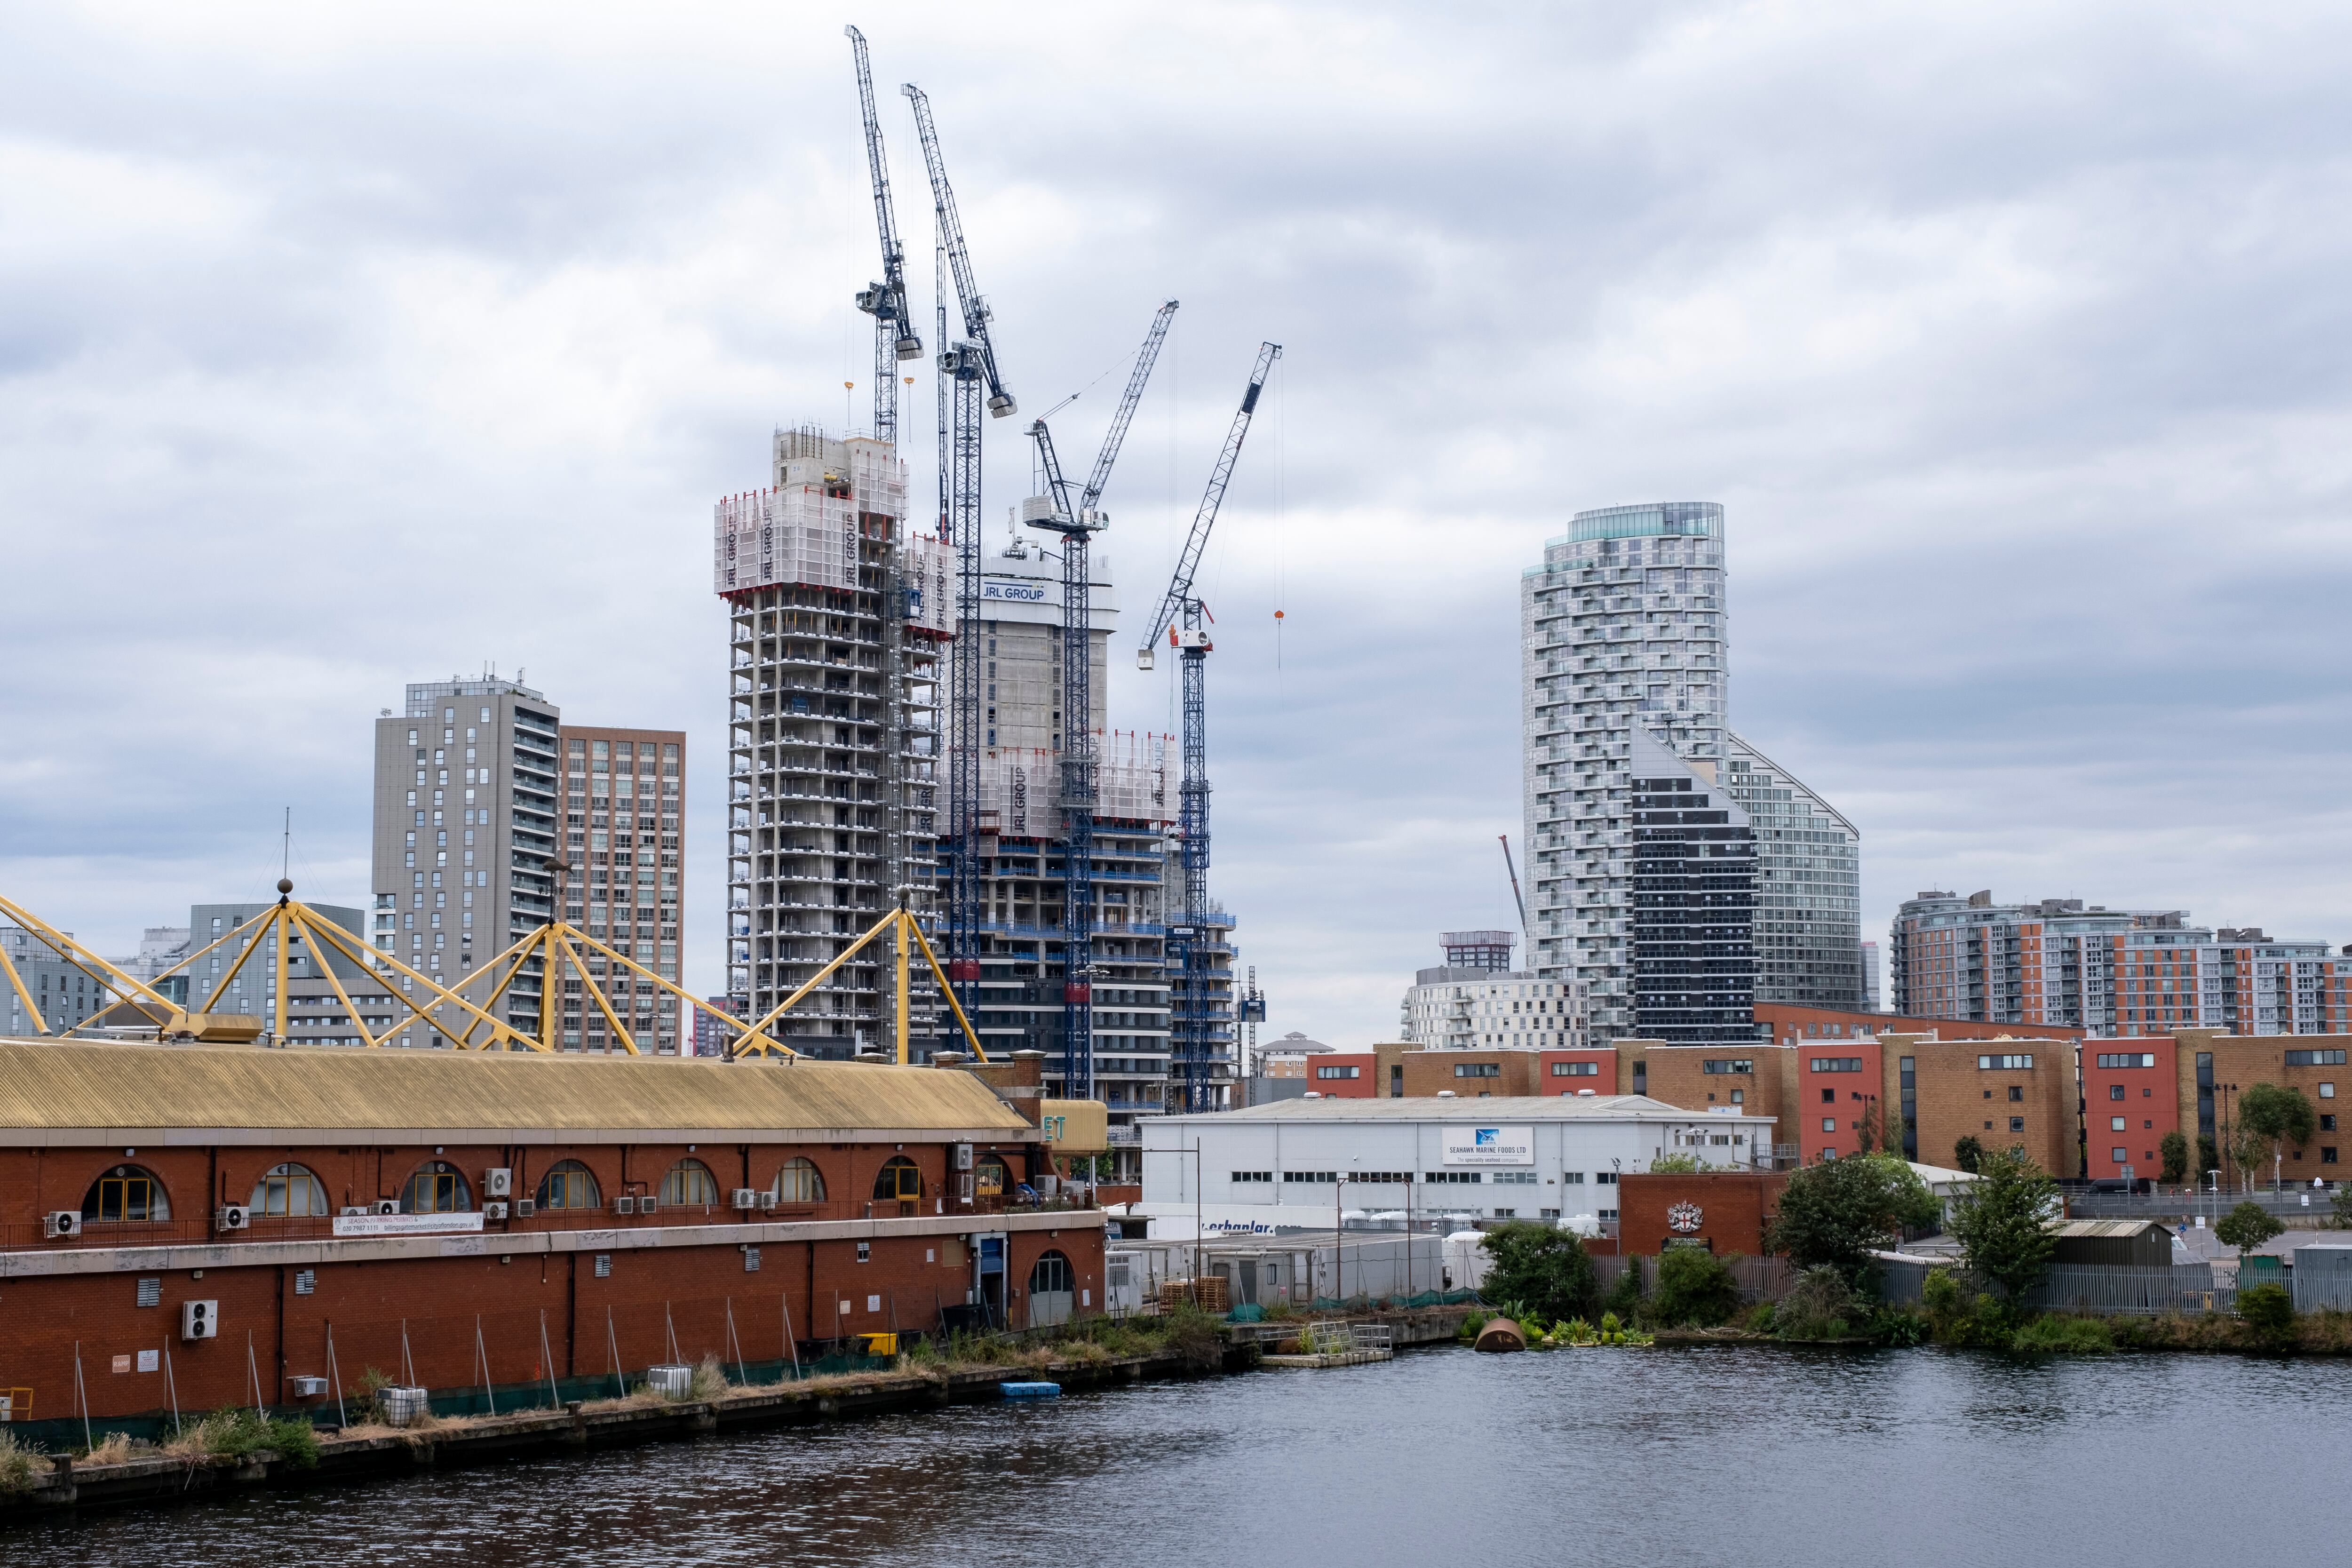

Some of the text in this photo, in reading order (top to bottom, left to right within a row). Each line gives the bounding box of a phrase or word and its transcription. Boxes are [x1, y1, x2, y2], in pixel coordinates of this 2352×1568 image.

[728, 516, 737, 561] GROUP
[846, 514, 856, 587] JRL GROUP
[984, 587, 1044, 600] JRL GROUP
[1015, 767, 1025, 833] JRL GROUP
[1155, 786, 1164, 807] JRL
